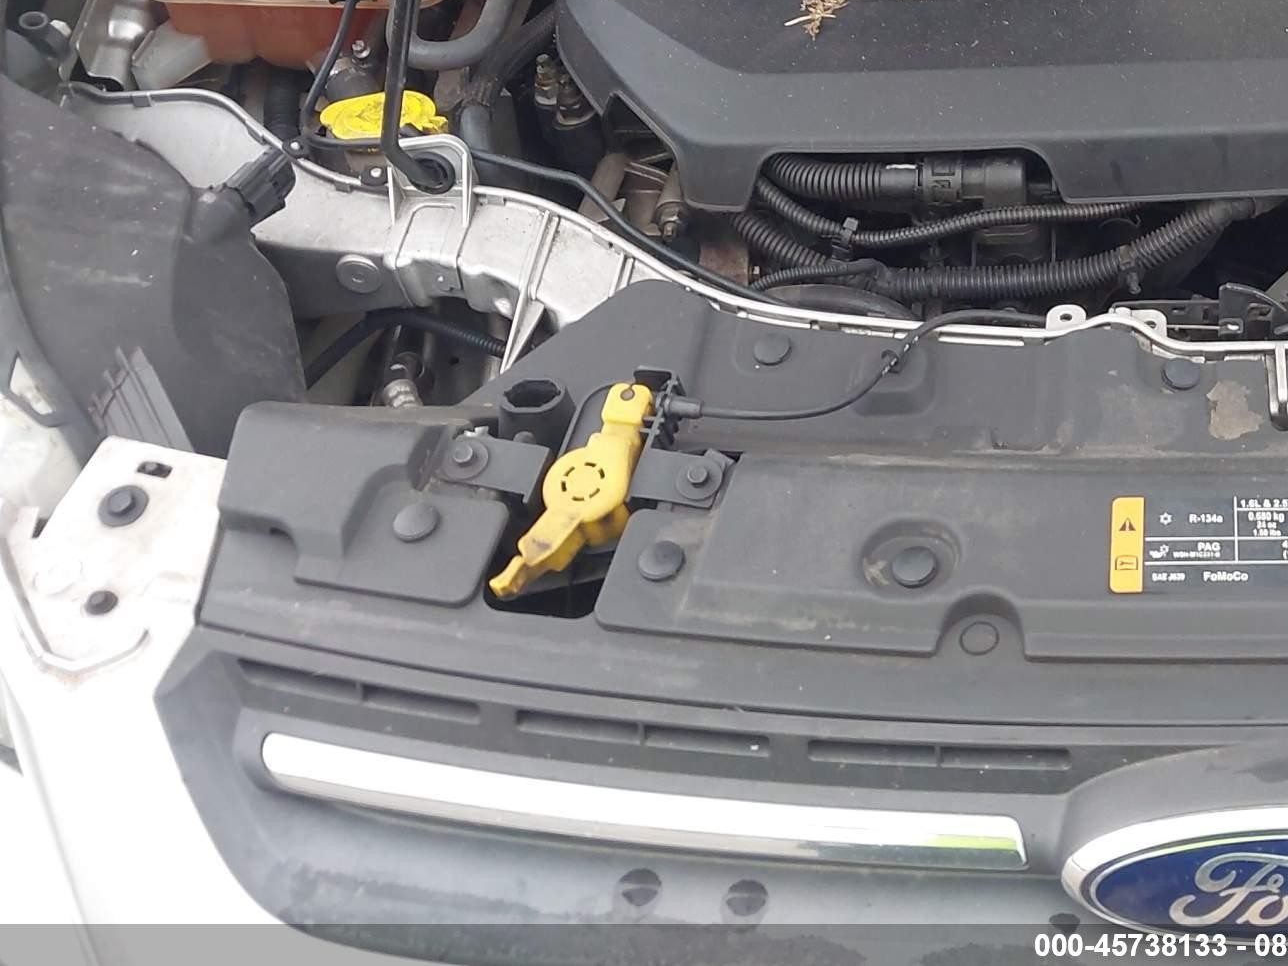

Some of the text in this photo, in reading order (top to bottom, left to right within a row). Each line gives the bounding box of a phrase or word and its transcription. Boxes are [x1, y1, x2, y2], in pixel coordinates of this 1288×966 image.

[1188, 513, 1224, 524] R-134a
[1273, 511, 1285, 523] kg
[1197, 541, 1221, 552] PAG
[1202, 570, 1249, 582] FoMoCo
